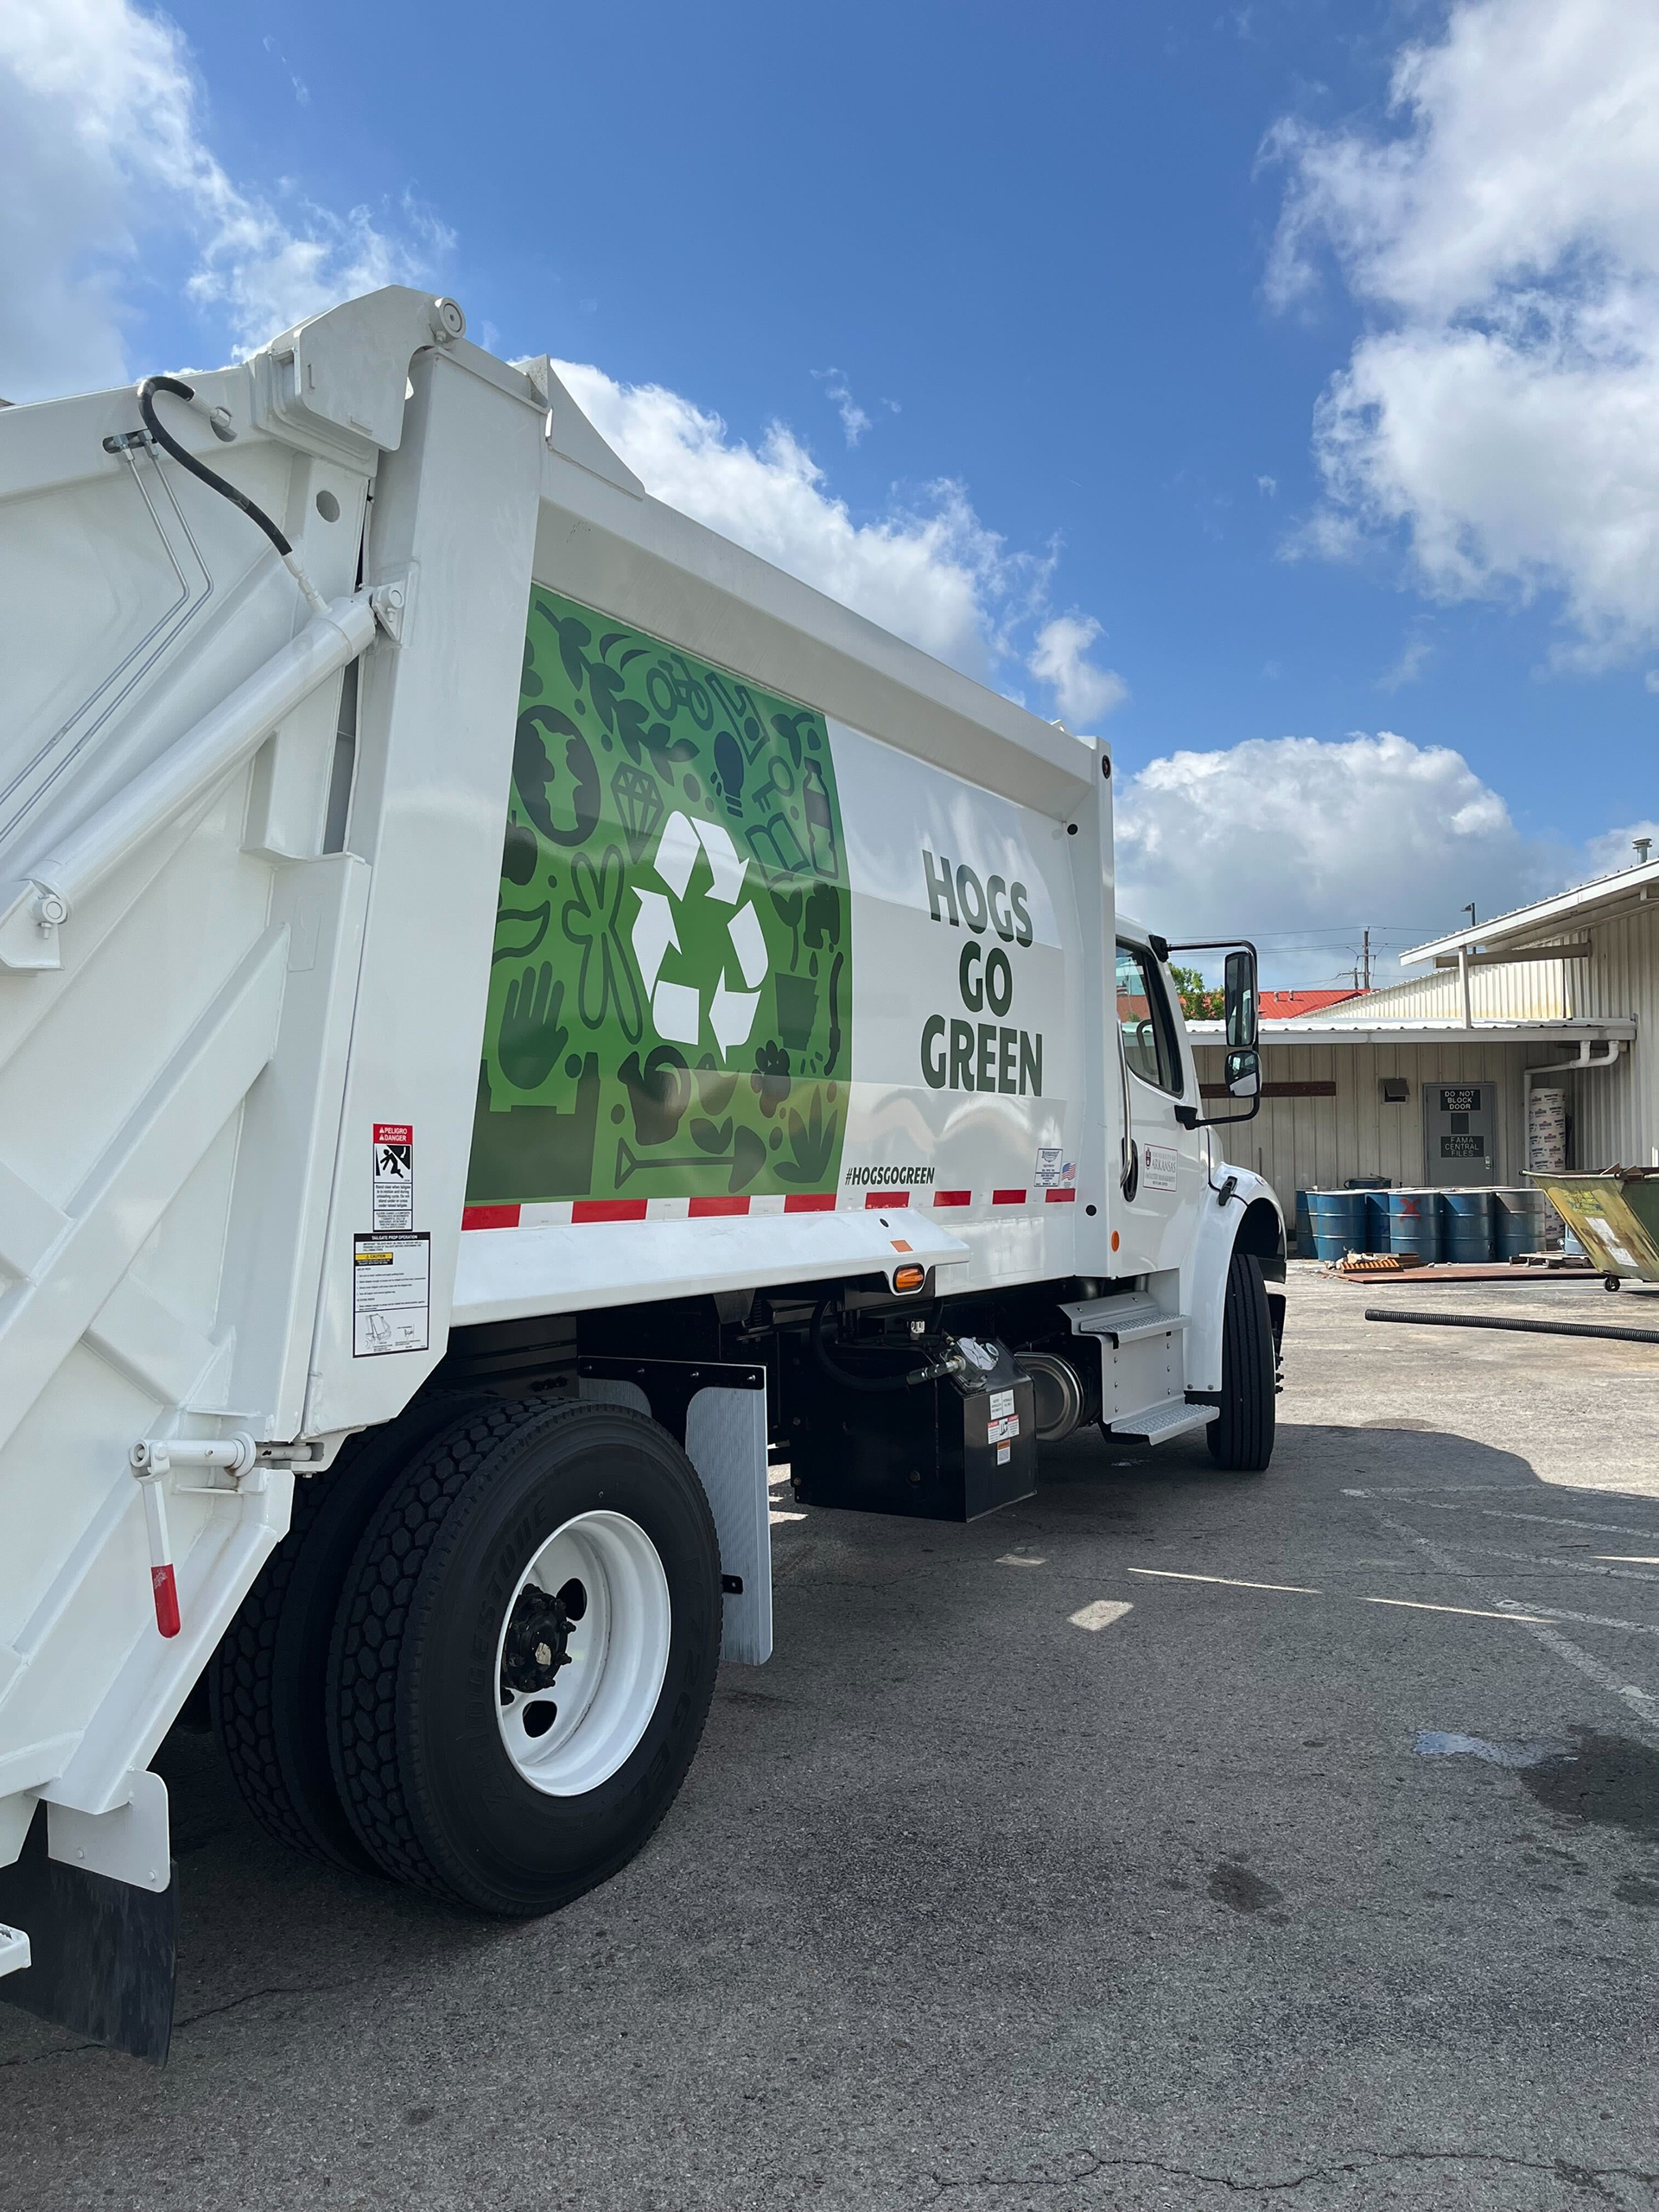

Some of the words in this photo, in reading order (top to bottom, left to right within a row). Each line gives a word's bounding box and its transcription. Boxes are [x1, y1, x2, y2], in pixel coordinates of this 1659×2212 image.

[923, 849, 1033, 948] HOGS
[959, 940, 1013, 1017] GO
[921, 1014, 1043, 1096] GREEN
[845, 1166, 935, 1185] #HOGSGOGREEN
[1152, 1159, 1176, 1173] ARKANSAS
[464, 1496, 549, 1815] BRIDGESTONE
